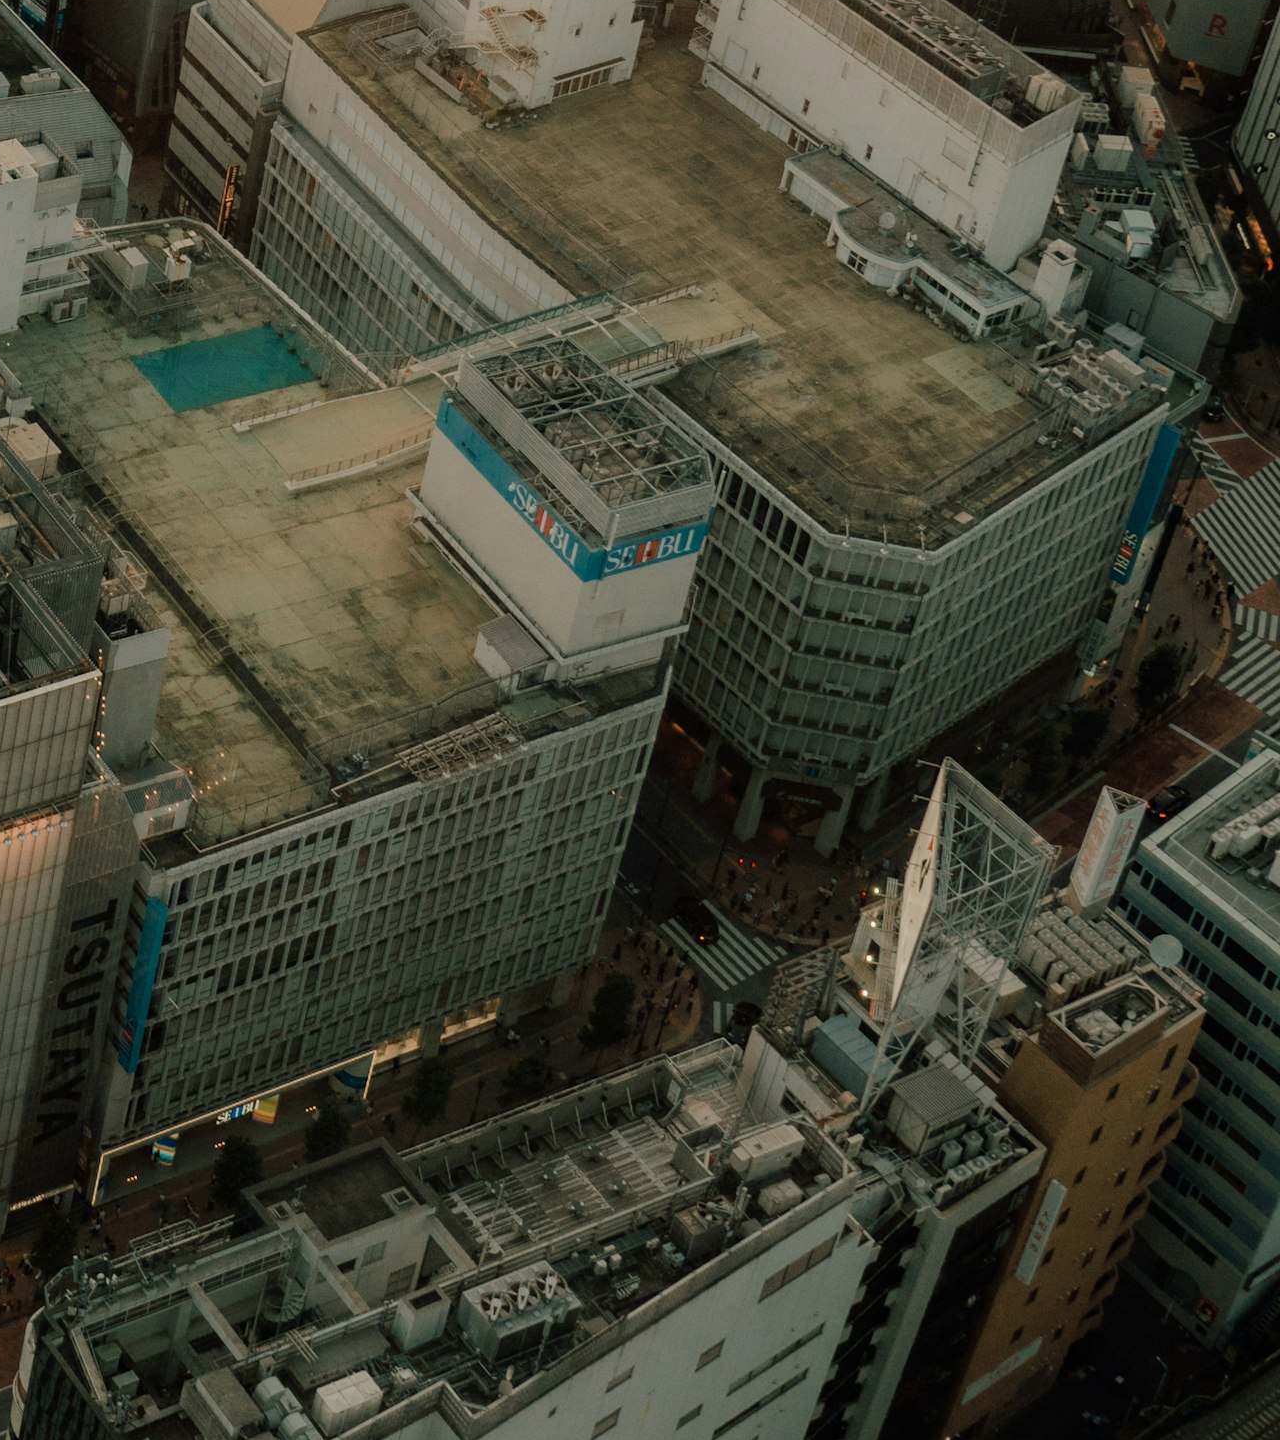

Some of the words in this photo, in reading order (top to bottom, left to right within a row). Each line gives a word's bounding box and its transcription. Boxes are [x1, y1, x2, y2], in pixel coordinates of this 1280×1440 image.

[518, 486, 589, 568] SEIBU
[606, 529, 695, 574] SEIBU
[1113, 530, 1141, 577] SEIBU
[32, 898, 117, 1148] TSUTAYA
[215, 1099, 260, 1125] SEIBU
